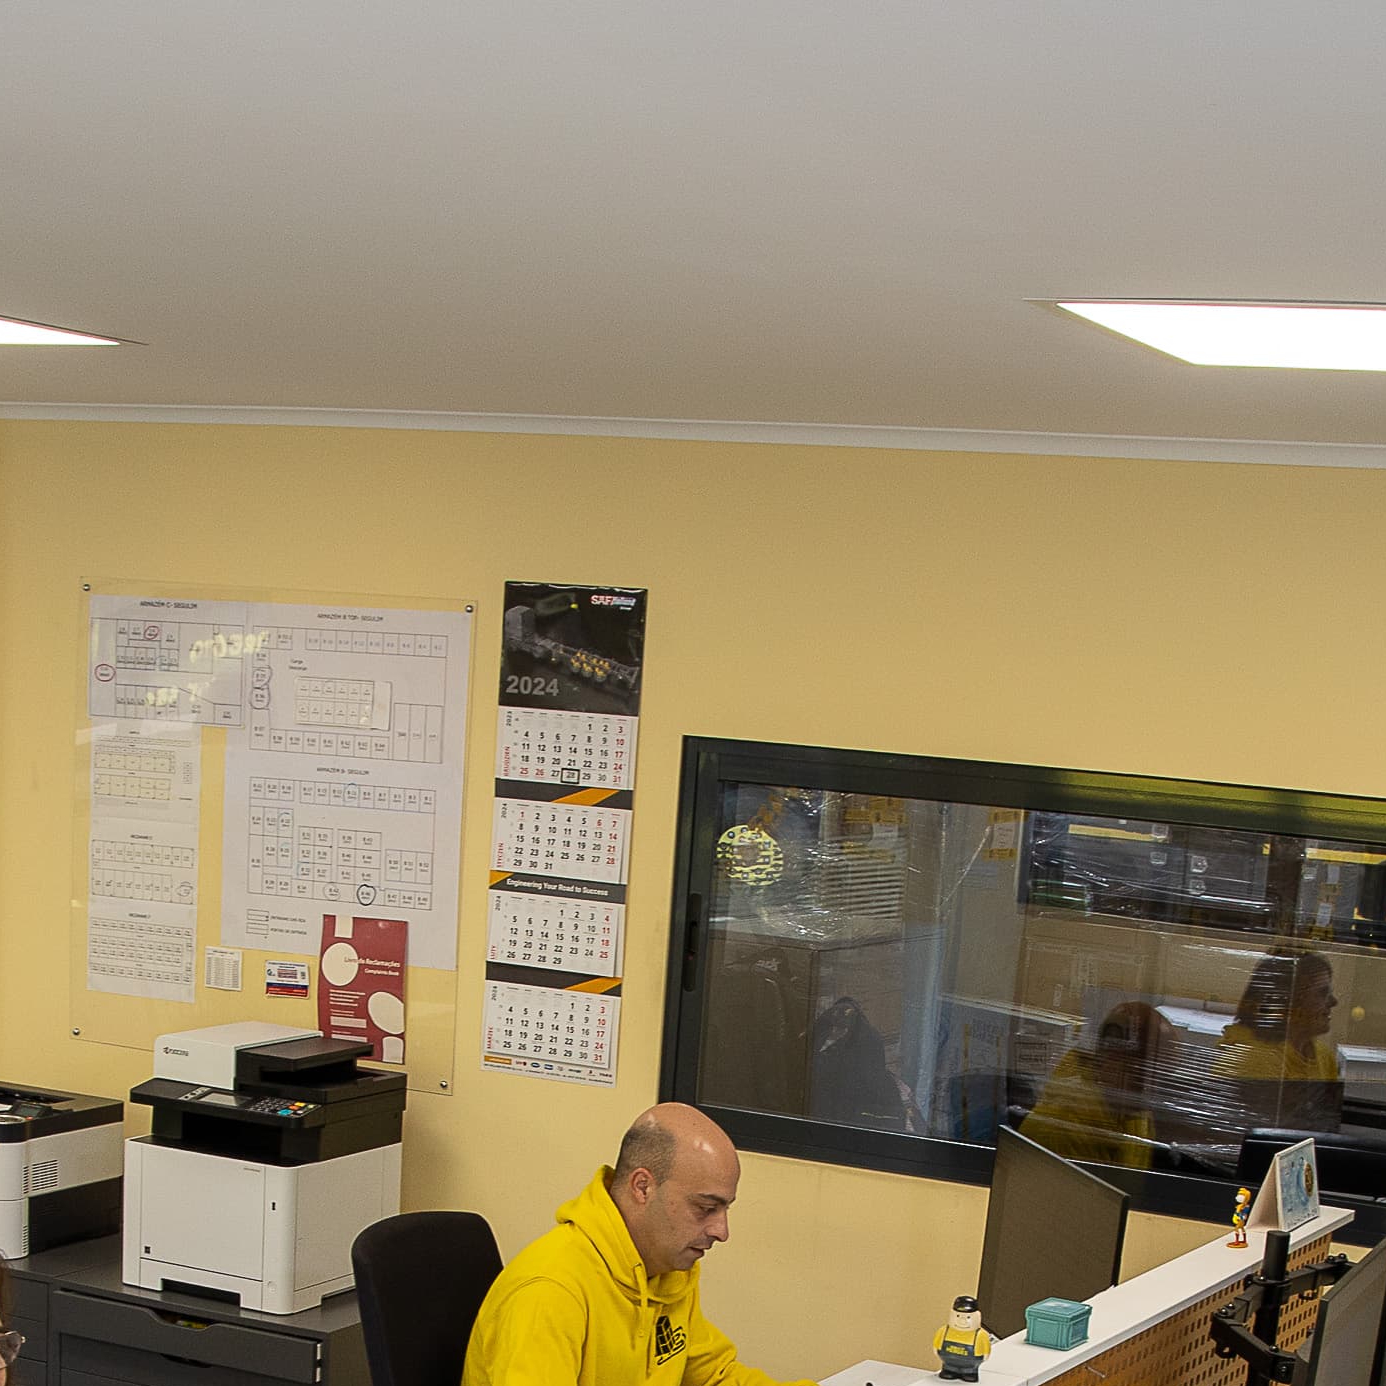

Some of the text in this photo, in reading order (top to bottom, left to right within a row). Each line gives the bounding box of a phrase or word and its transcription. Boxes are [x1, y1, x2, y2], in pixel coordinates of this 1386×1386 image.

[506, 676, 559, 695] 2024
[544, 862, 553, 870] 31
[507, 879, 542, 890] Engineering
[543, 881, 557, 890] Your
